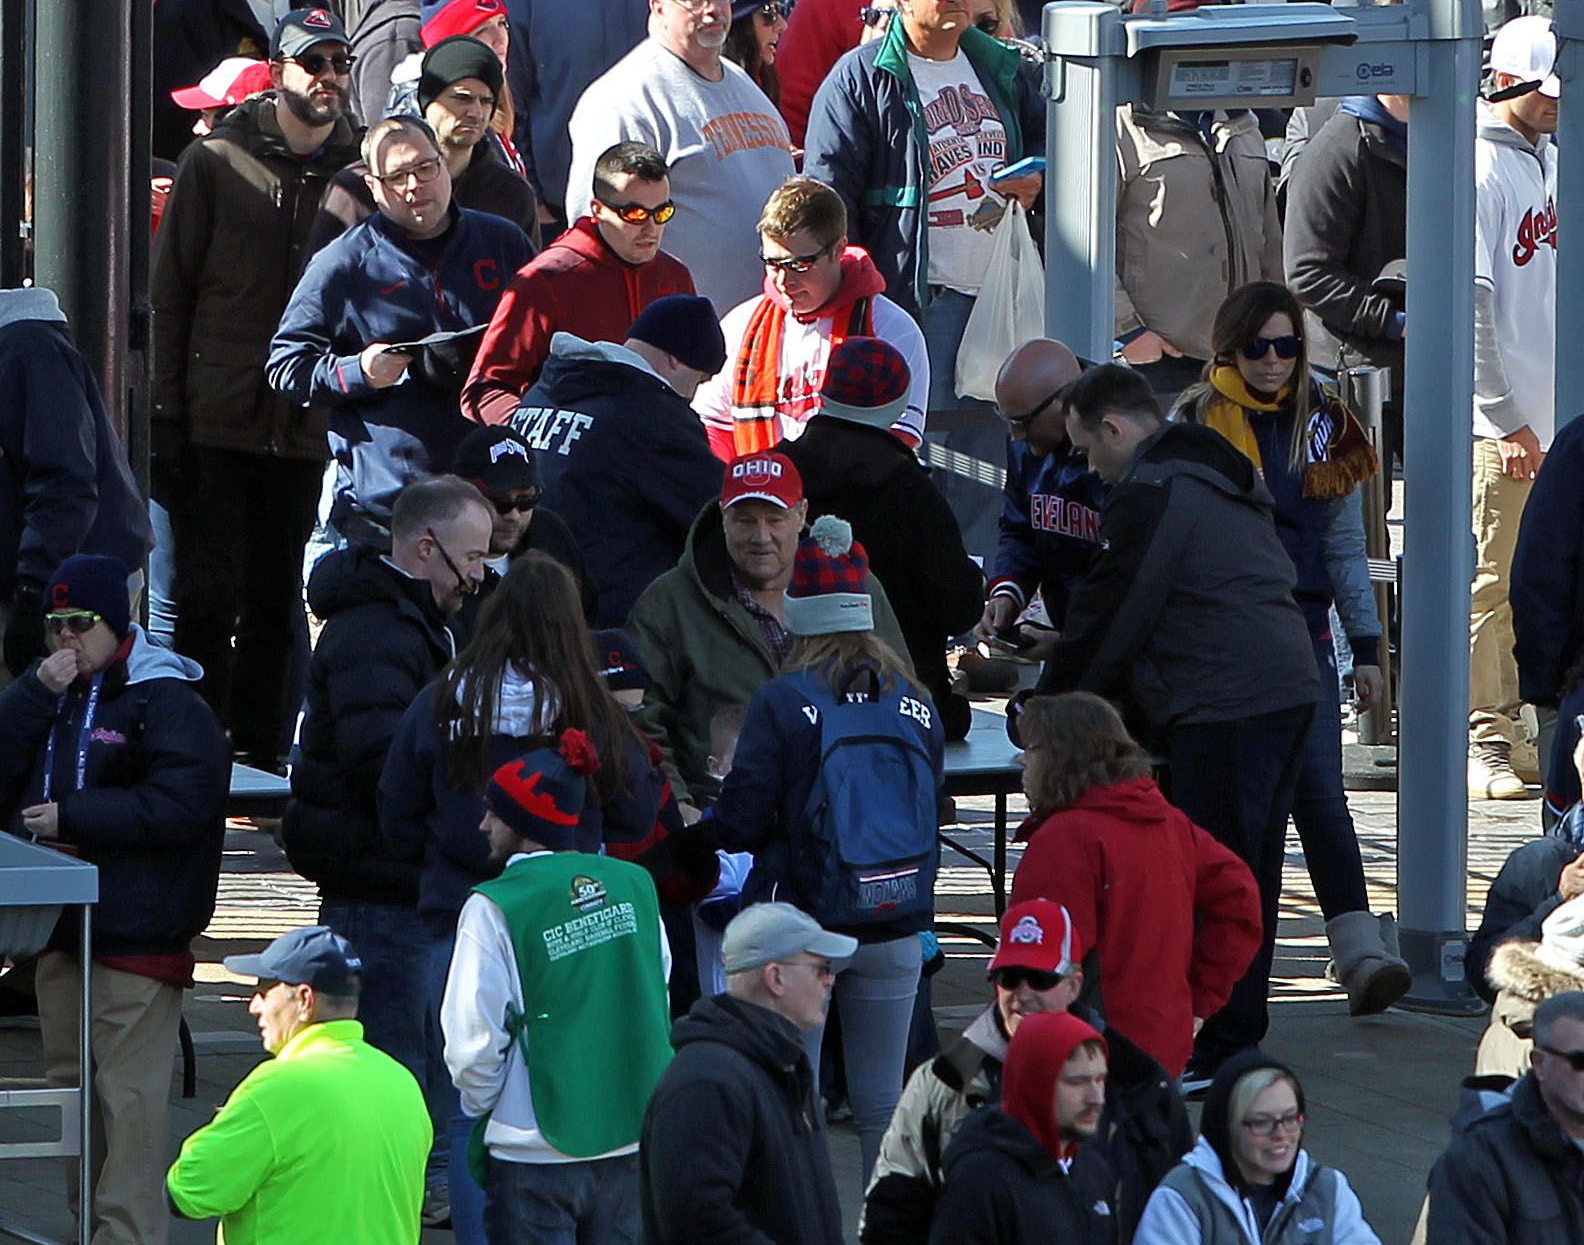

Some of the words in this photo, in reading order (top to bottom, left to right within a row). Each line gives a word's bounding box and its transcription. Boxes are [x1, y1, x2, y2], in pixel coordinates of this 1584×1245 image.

[474, 260, 499, 290] C
[732, 460, 782, 477] OHIO
[542, 925, 563, 942] CIC
